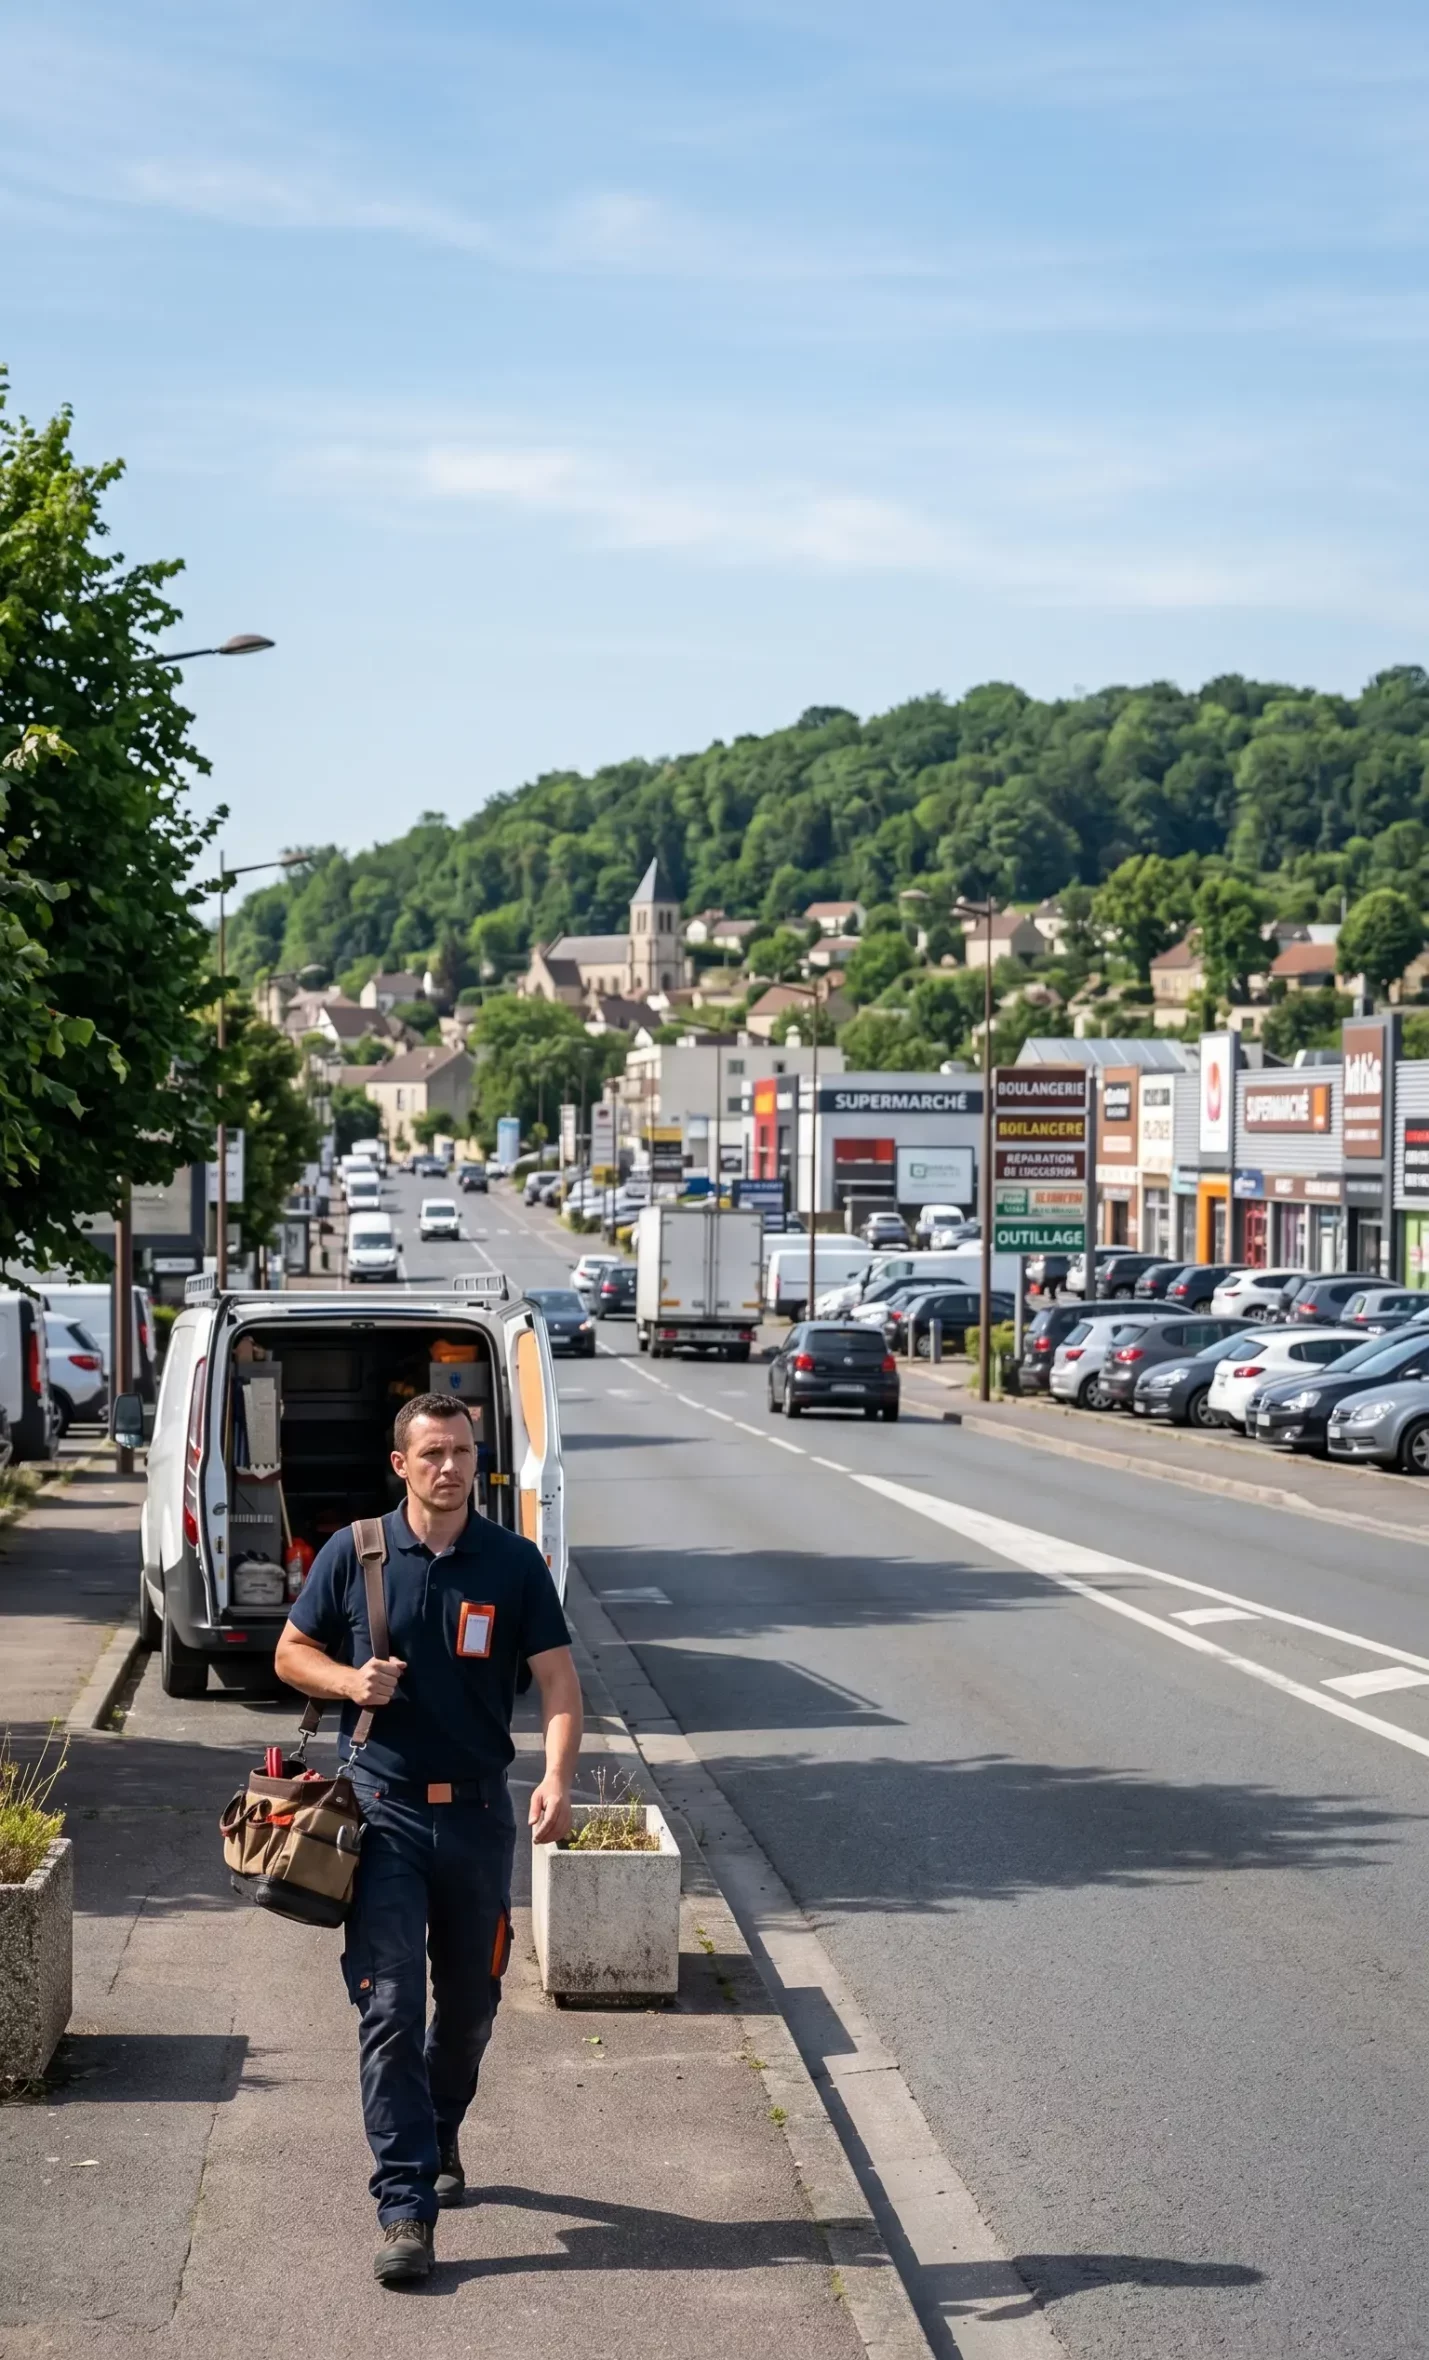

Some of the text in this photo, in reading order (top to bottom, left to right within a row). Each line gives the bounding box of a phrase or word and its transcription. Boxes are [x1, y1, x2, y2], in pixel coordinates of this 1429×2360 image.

[998, 1081, 1084, 1096] BOULANGERIE
[835, 1091, 967, 1110] SUPERMARCHÉ
[1006, 1152, 1075, 1164] RÉPARATION
[997, 1230, 1083, 1245] OUTILLAGE
